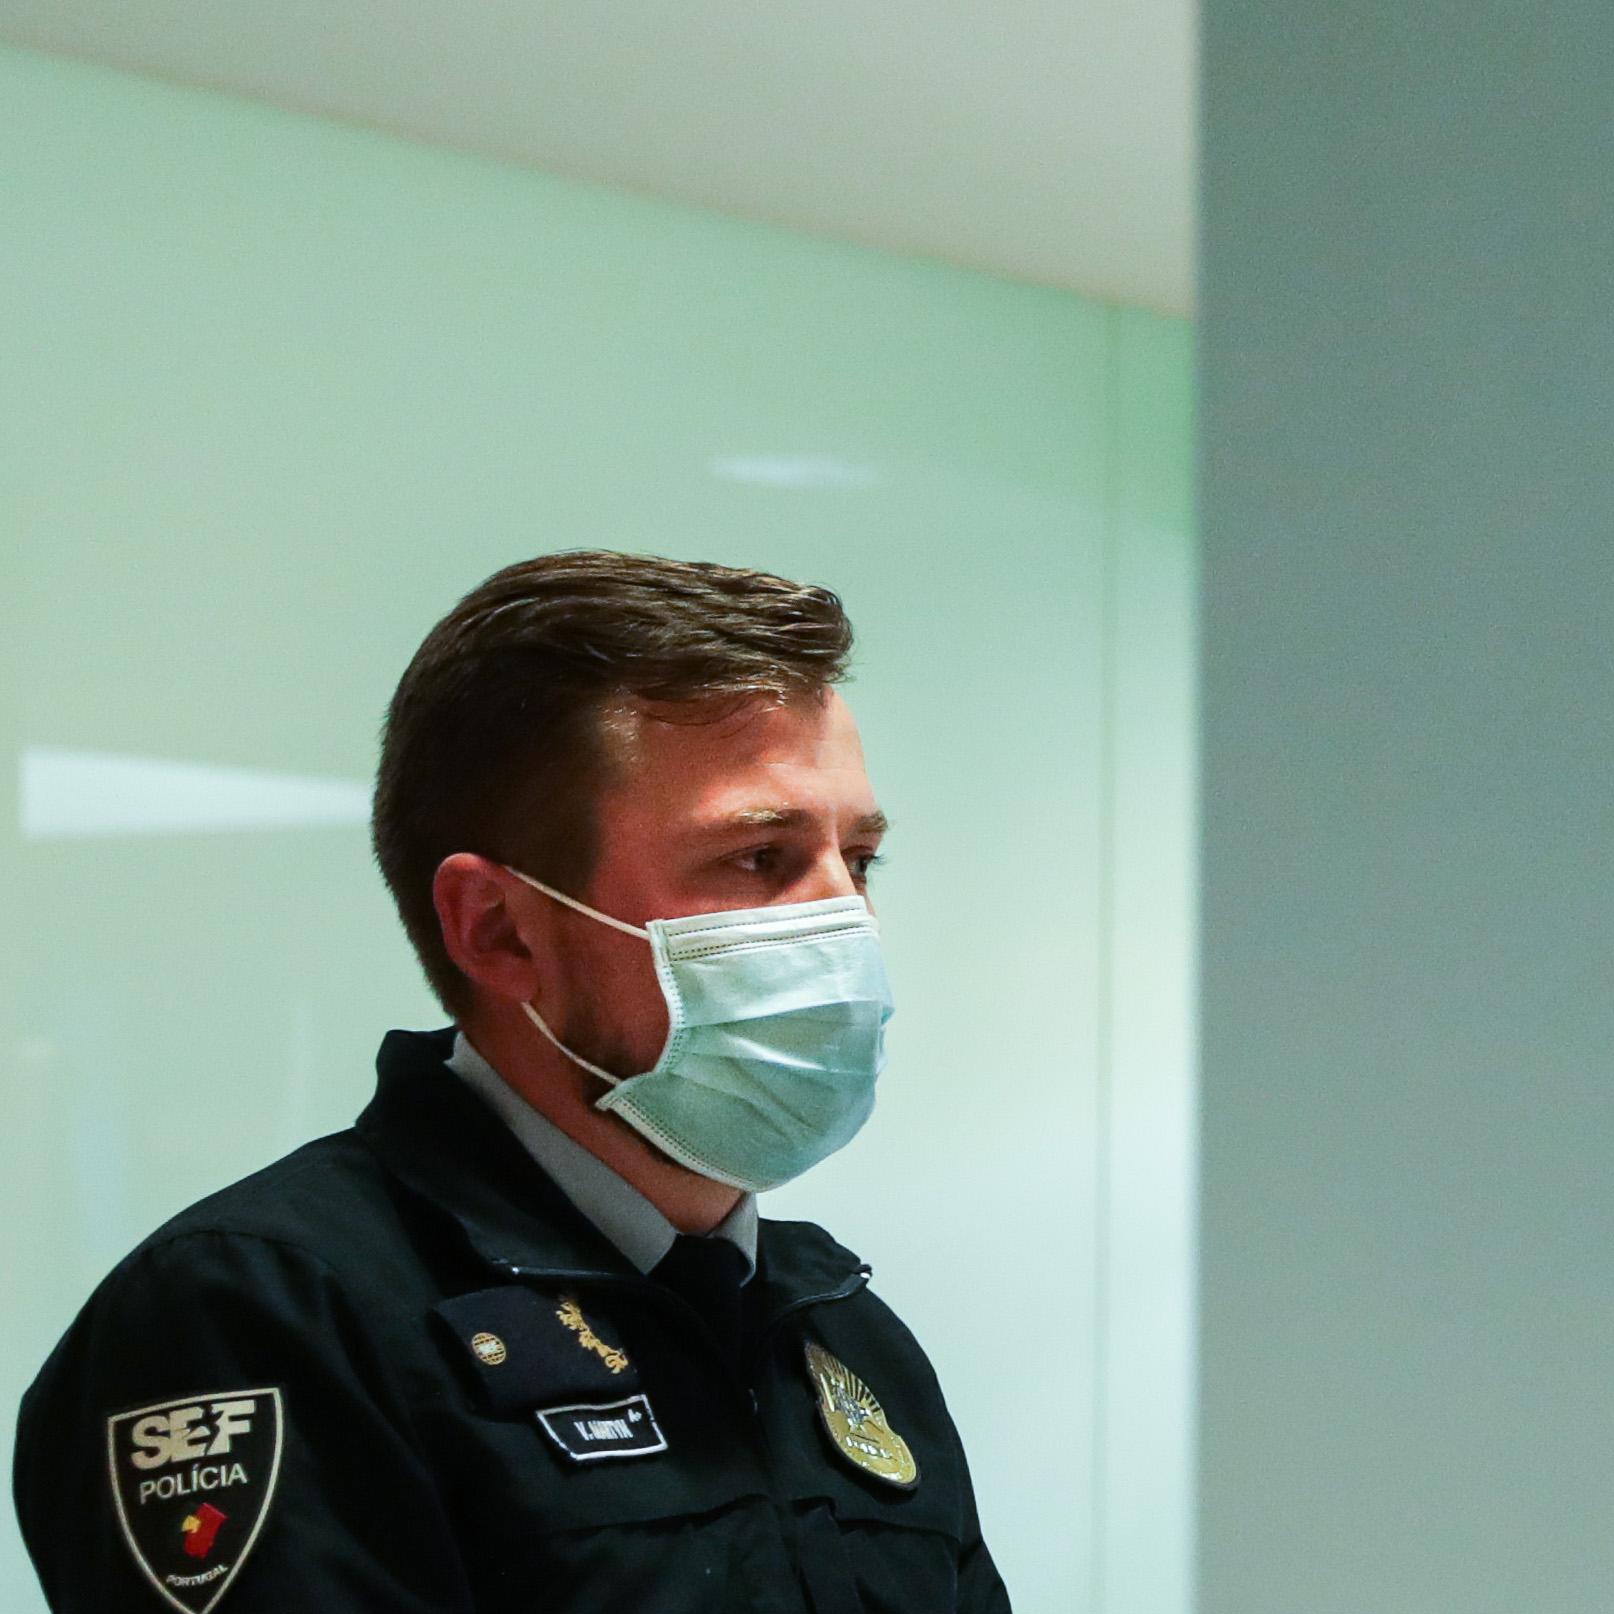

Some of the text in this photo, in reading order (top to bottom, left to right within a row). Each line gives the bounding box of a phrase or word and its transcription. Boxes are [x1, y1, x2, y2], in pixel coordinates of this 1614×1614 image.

[131, 1399, 256, 1471] SEF
[139, 1463, 248, 1505] POLÍCIA
[166, 1563, 229, 1587] PORTUGAL
